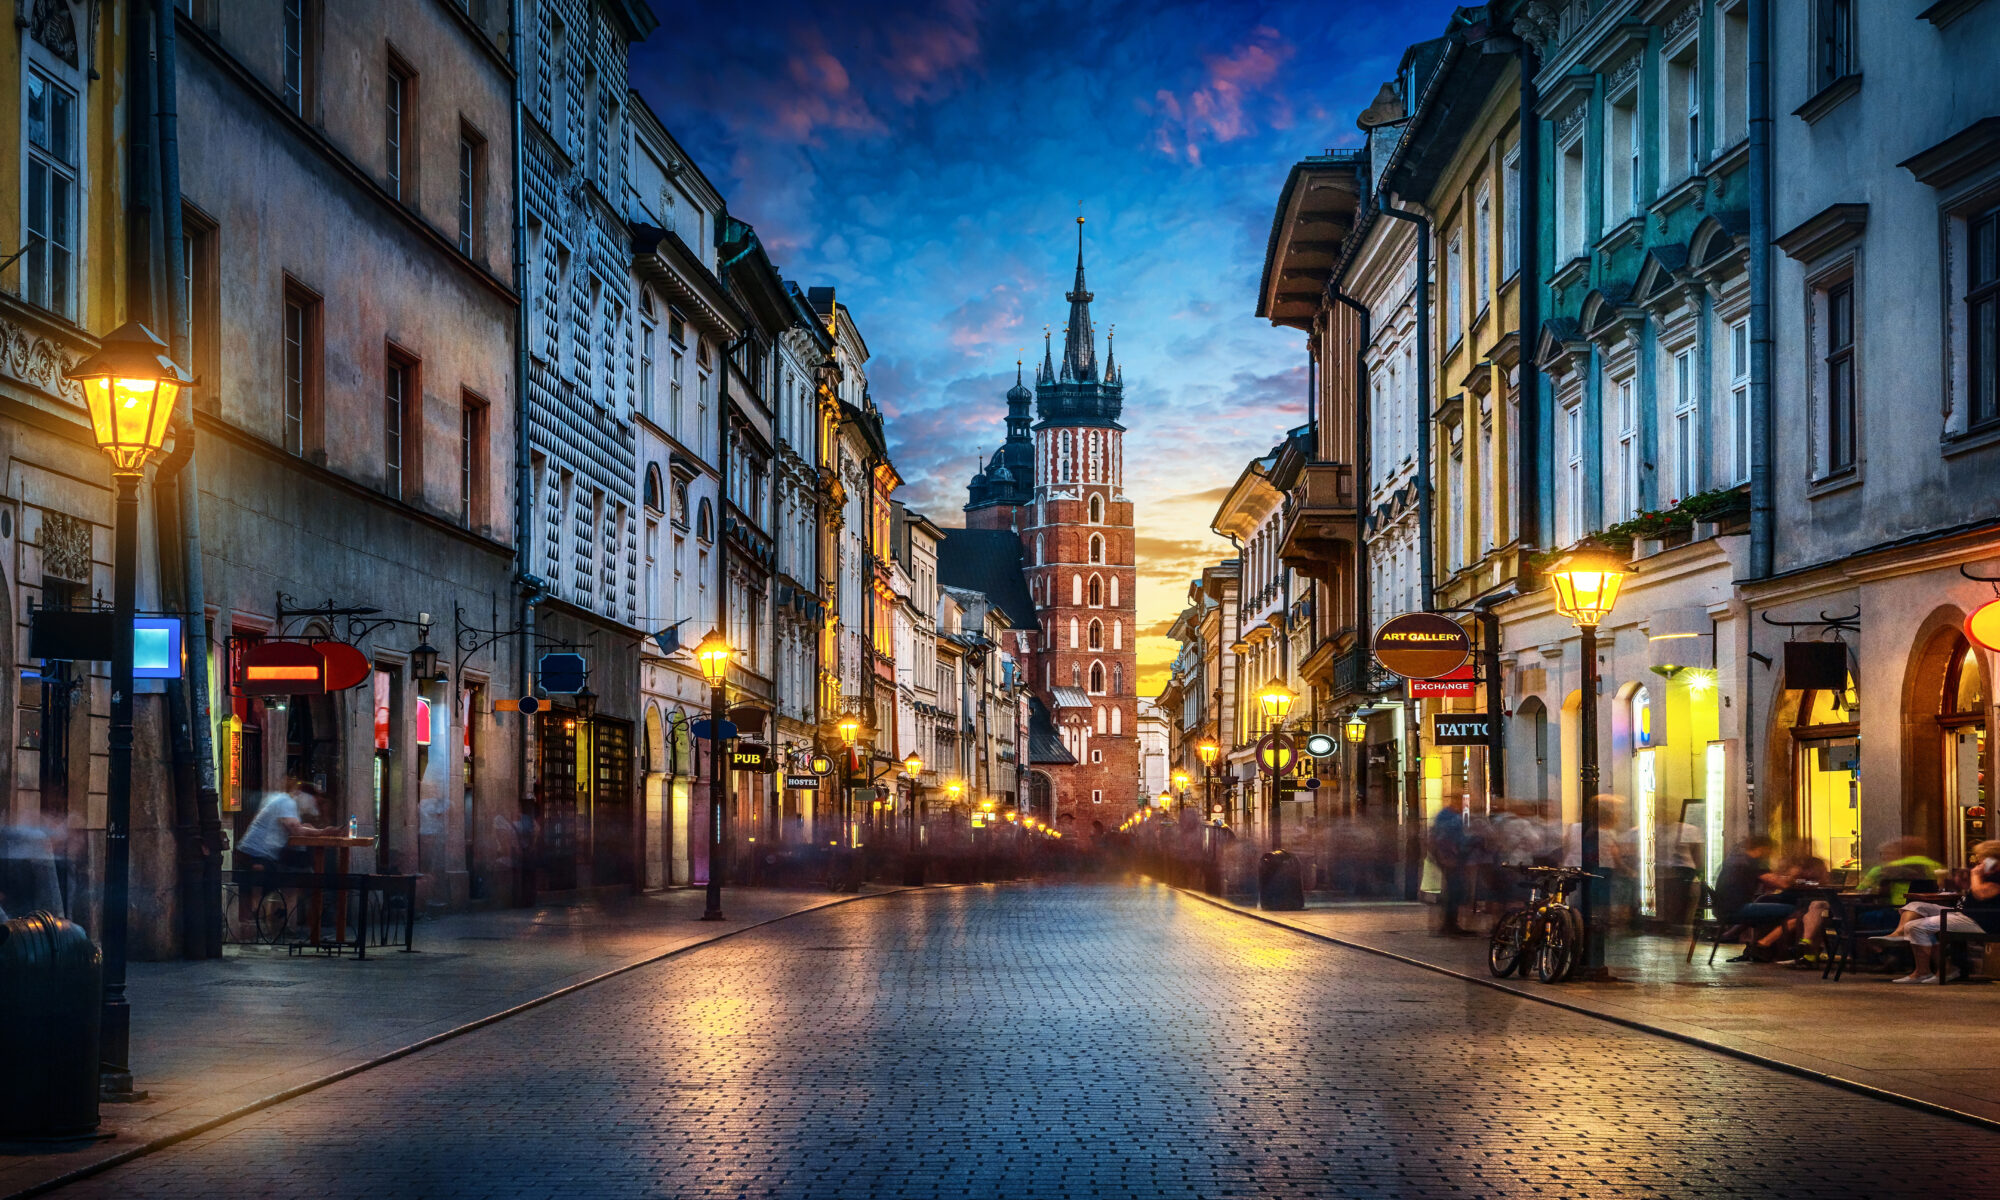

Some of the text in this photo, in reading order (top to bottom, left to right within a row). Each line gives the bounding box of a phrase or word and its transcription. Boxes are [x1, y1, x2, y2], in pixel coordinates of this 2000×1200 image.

[1383, 633, 1461, 641] ART GALLERY
[734, 754, 760, 764] PUB
